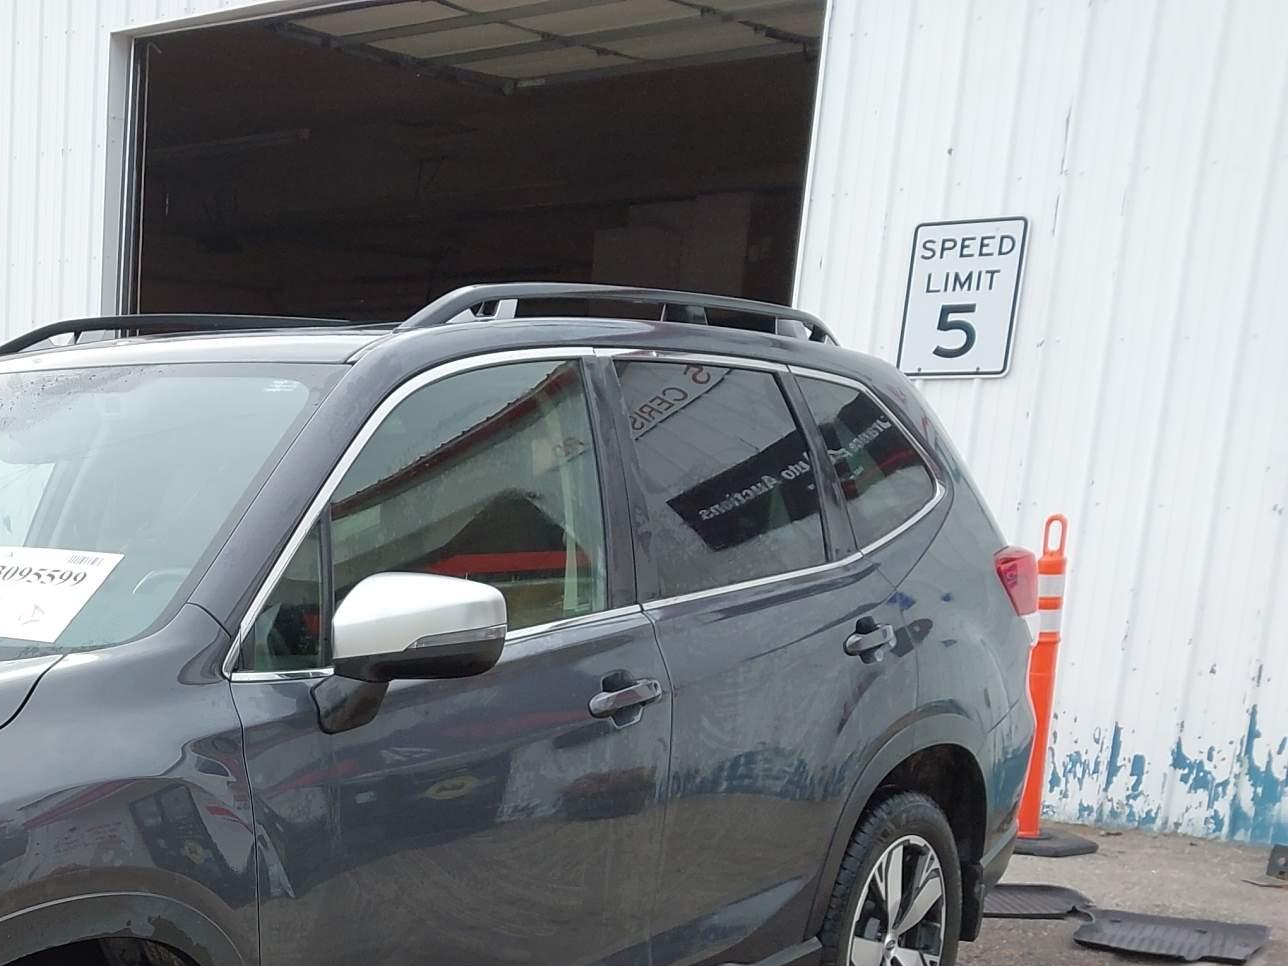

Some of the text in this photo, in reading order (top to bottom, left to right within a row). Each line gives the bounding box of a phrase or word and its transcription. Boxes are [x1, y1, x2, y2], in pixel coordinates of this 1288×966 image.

[920, 235, 1016, 260] SPEED
[925, 269, 1001, 293] LIMIT
[932, 303, 977, 359] 5
